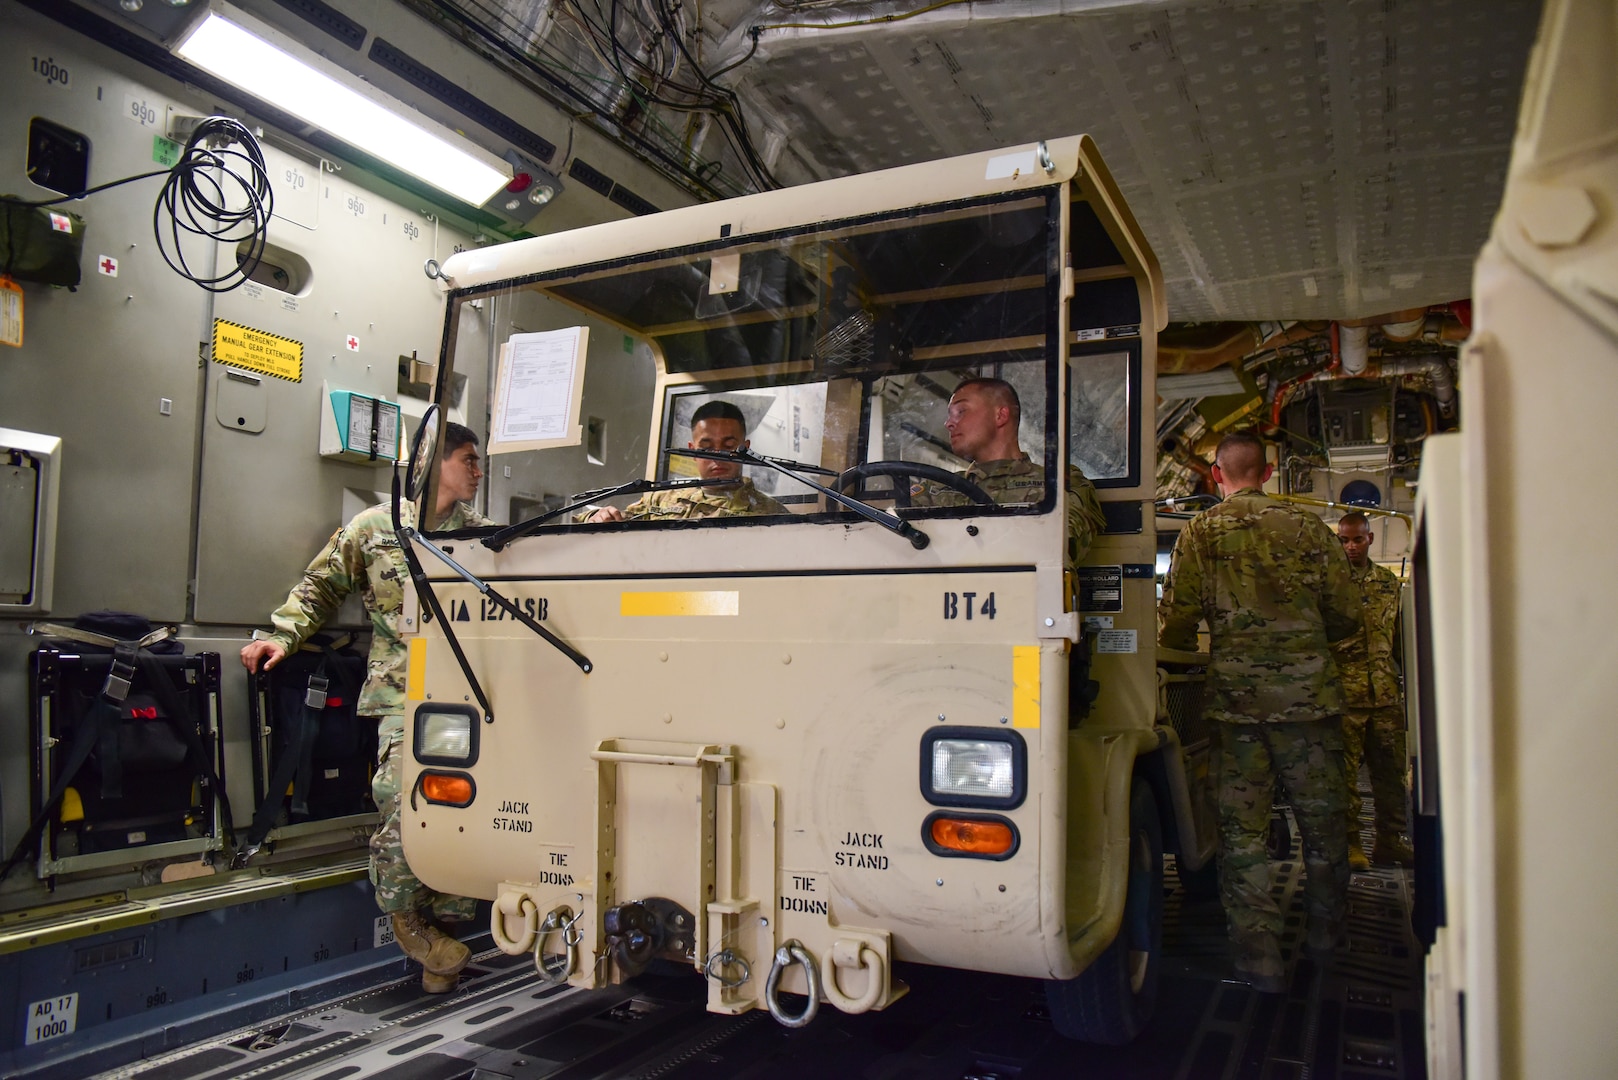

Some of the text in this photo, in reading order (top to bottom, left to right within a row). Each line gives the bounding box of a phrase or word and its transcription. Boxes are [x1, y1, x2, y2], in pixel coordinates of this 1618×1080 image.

[32, 57, 68, 85] 1000
[131, 102, 155, 124] 990
[286, 169, 304, 188] 970
[348, 198, 364, 214] 960
[404, 223, 419, 238] 950
[243, 332, 277, 347] EMERGENCY
[222, 335, 296, 362] MANUAL GEAR EXTENSION
[237, 356, 252, 365] HANDLE
[253, 360, 265, 368] DOWN
[250, 353, 265, 362] DEPLOY
[498, 800, 529, 815] JACK
[493, 817, 533, 833] STAND
[841, 832, 883, 848] JACK
[549, 852, 568, 867] TIE
[835, 851, 888, 870] STAND
[540, 871, 574, 886] DOWN
[792, 876, 816, 892] TIE
[780, 896, 827, 915] DOWN
[378, 918, 387, 928] AD
[380, 931, 394, 945] 960
[314, 948, 329, 962] 970
[236, 968, 254, 984] 980
[35, 996, 72, 1017] AD 17
[146, 991, 167, 1009] 990
[35, 1019, 67, 1041] 1000
